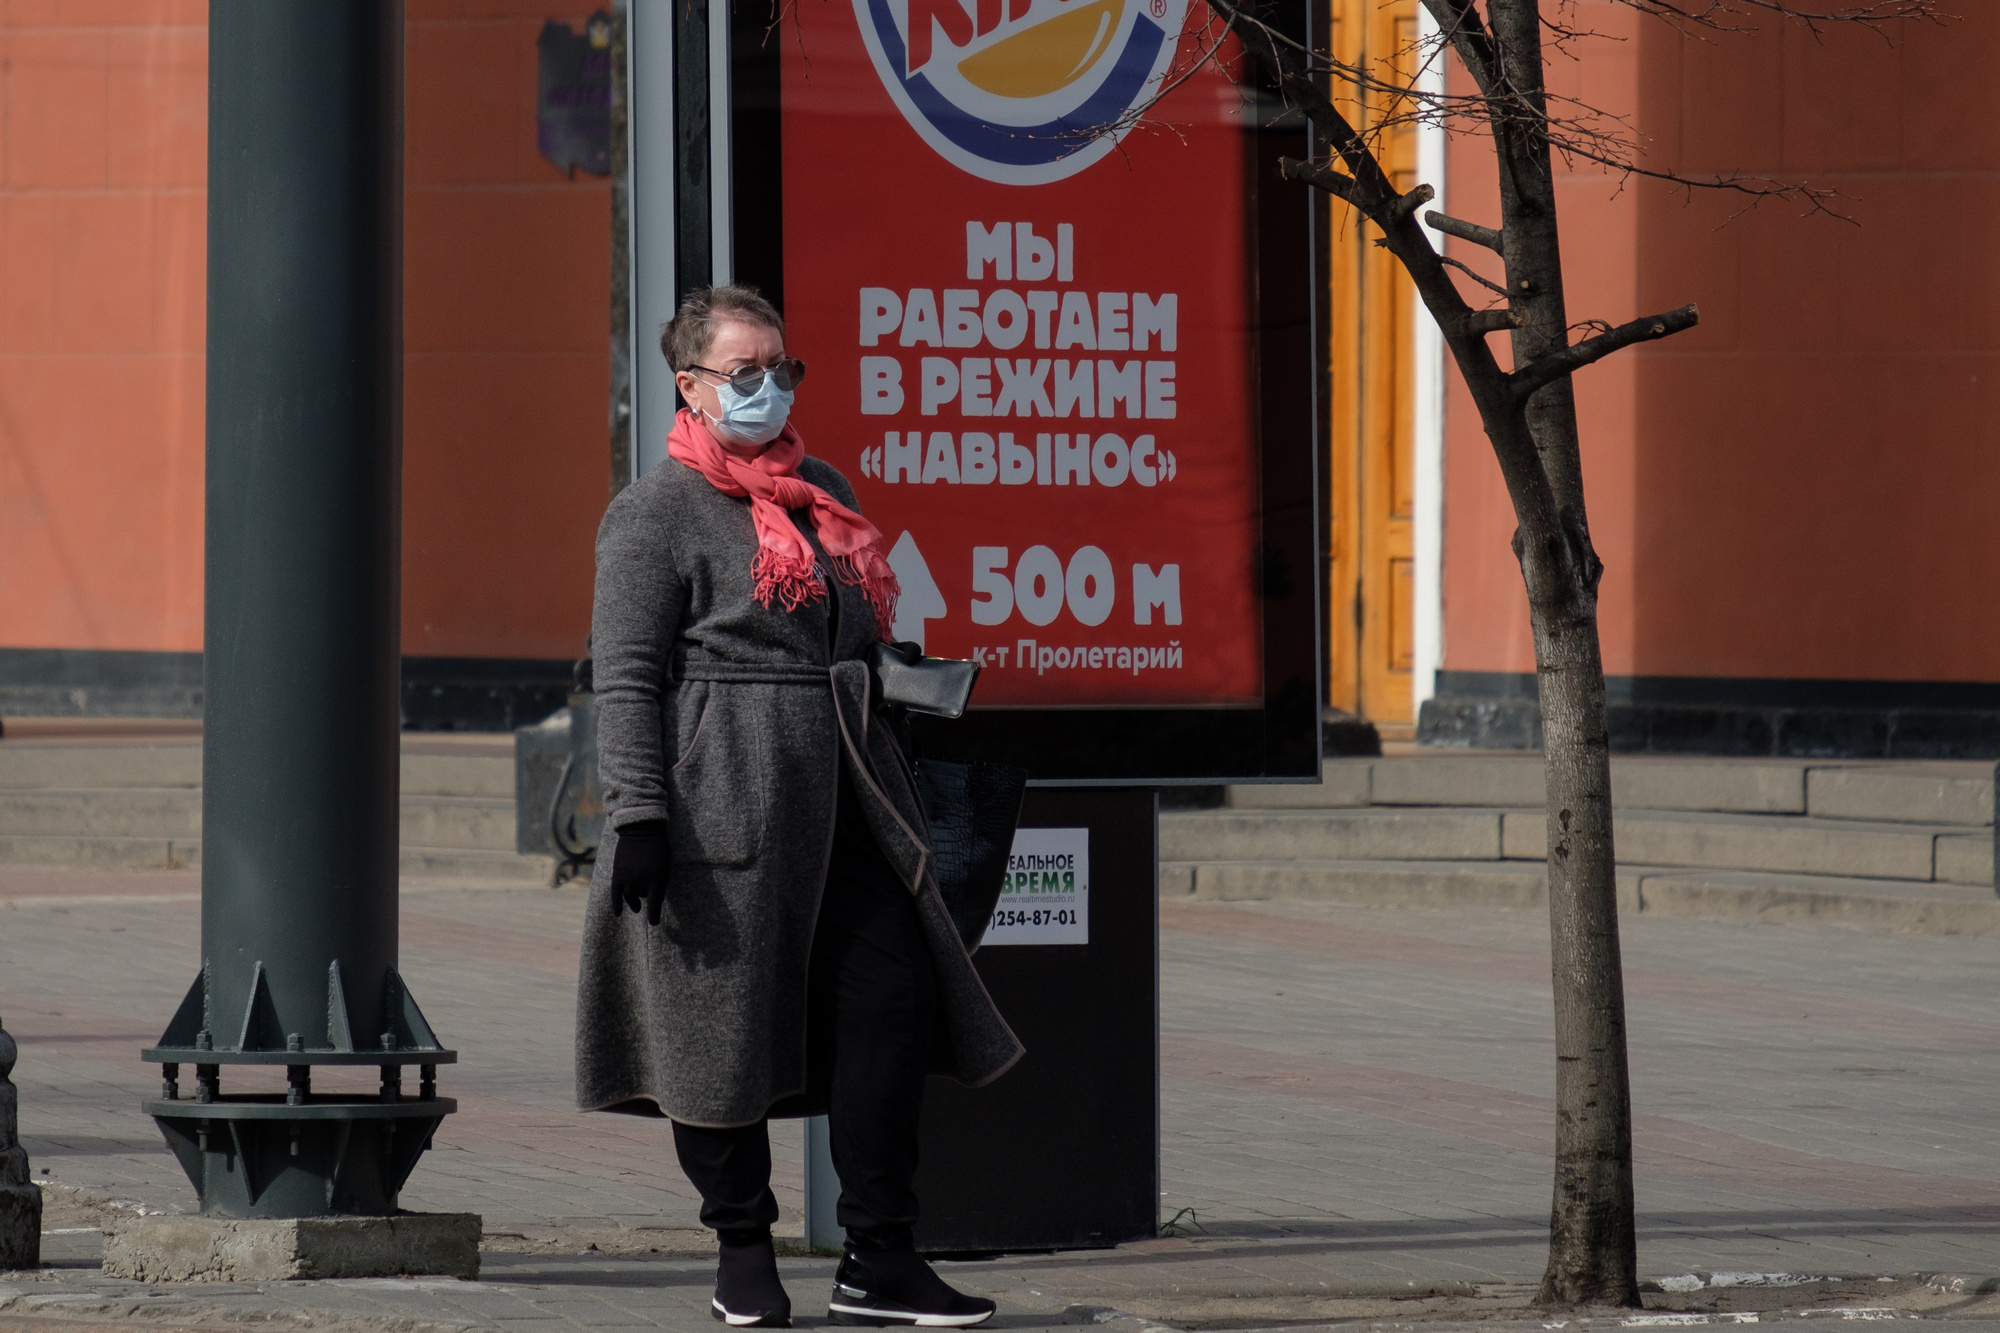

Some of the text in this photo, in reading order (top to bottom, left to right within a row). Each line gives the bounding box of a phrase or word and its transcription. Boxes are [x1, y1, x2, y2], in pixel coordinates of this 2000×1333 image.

[966, 221, 1074, 282] МЫ
[859, 287, 1178, 352] РАБОТАЕМ
[860, 356, 1176, 419] В РЕЖИМЕ
[860, 431, 1177, 487] «НАВЫНОС»
[971, 545, 1115, 626] 500
[972, 639, 1183, 676] к-т Пролетарий
[1001, 871, 1075, 894] ВРЕМЯ
[1008, 854, 1074, 871] ЕАЛЬНОЕ
[987, 909, 1077, 930] )254-87-01
[1001, 895, 1075, 904] www.realtimestudio.ru
